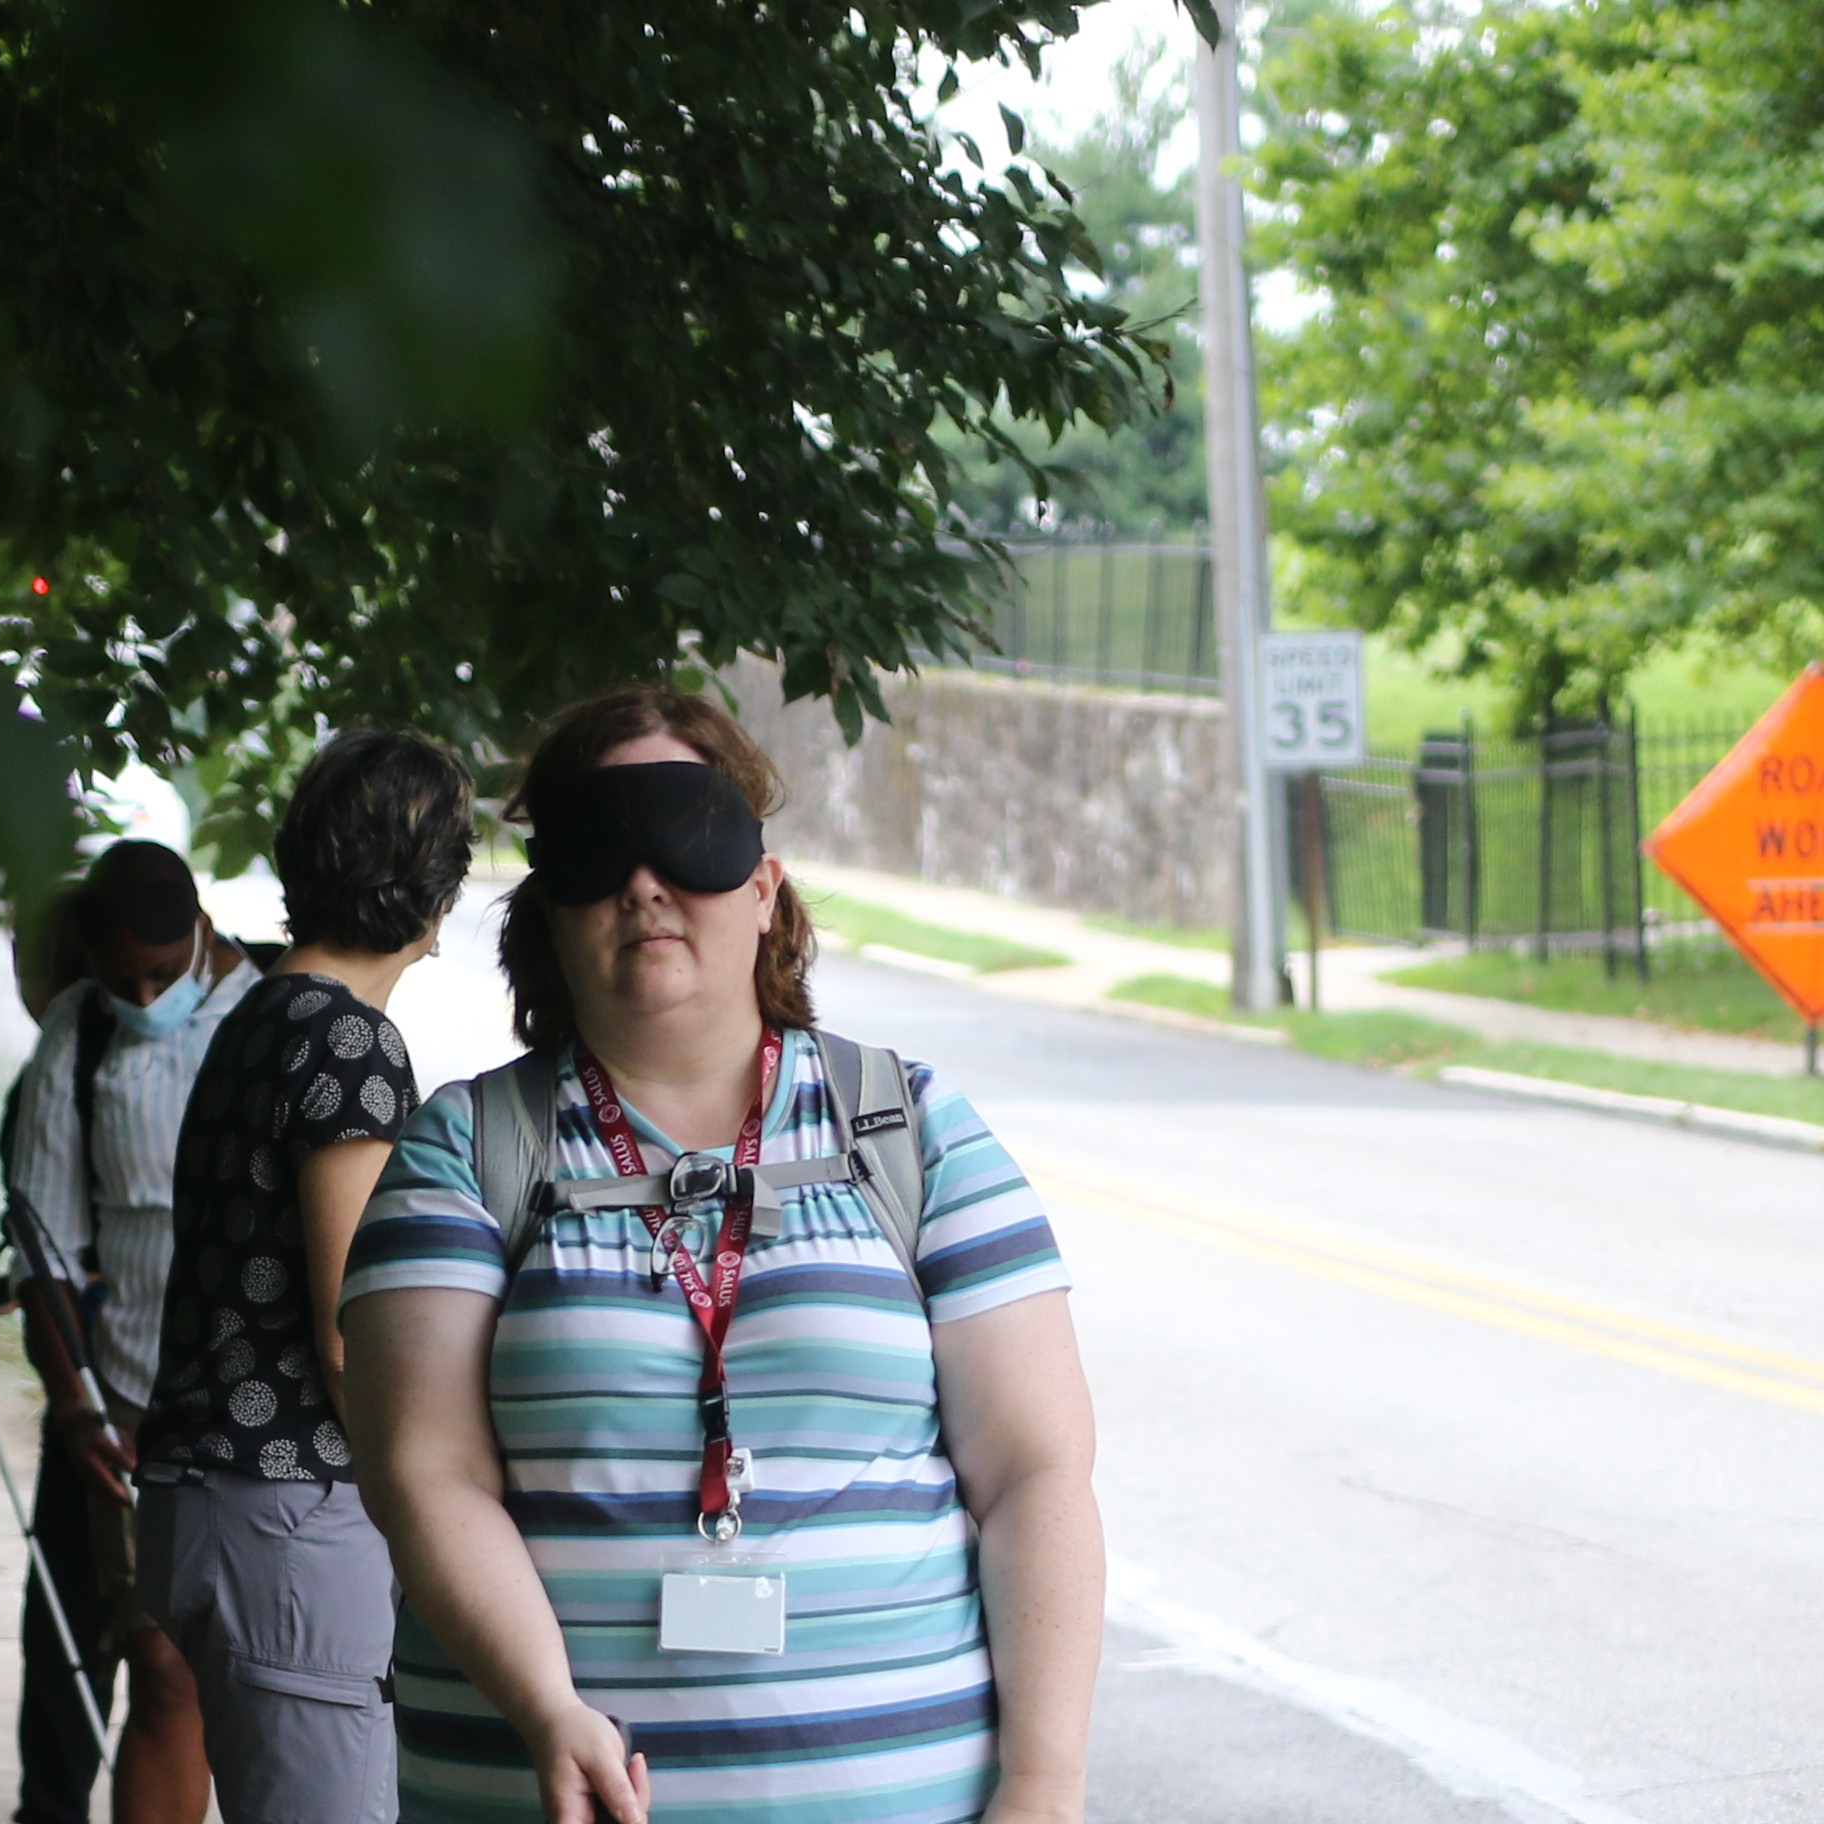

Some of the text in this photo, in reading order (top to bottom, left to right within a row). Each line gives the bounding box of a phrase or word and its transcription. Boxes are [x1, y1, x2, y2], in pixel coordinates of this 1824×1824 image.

[1271, 701, 1353, 749] 35
[583, 1066, 607, 1105] SALUS
[610, 1133, 636, 1175] SALUS
[743, 1138, 758, 1168] SAL
[730, 1210, 748, 1241] SALUS
[719, 1269, 736, 1307] SALUS
